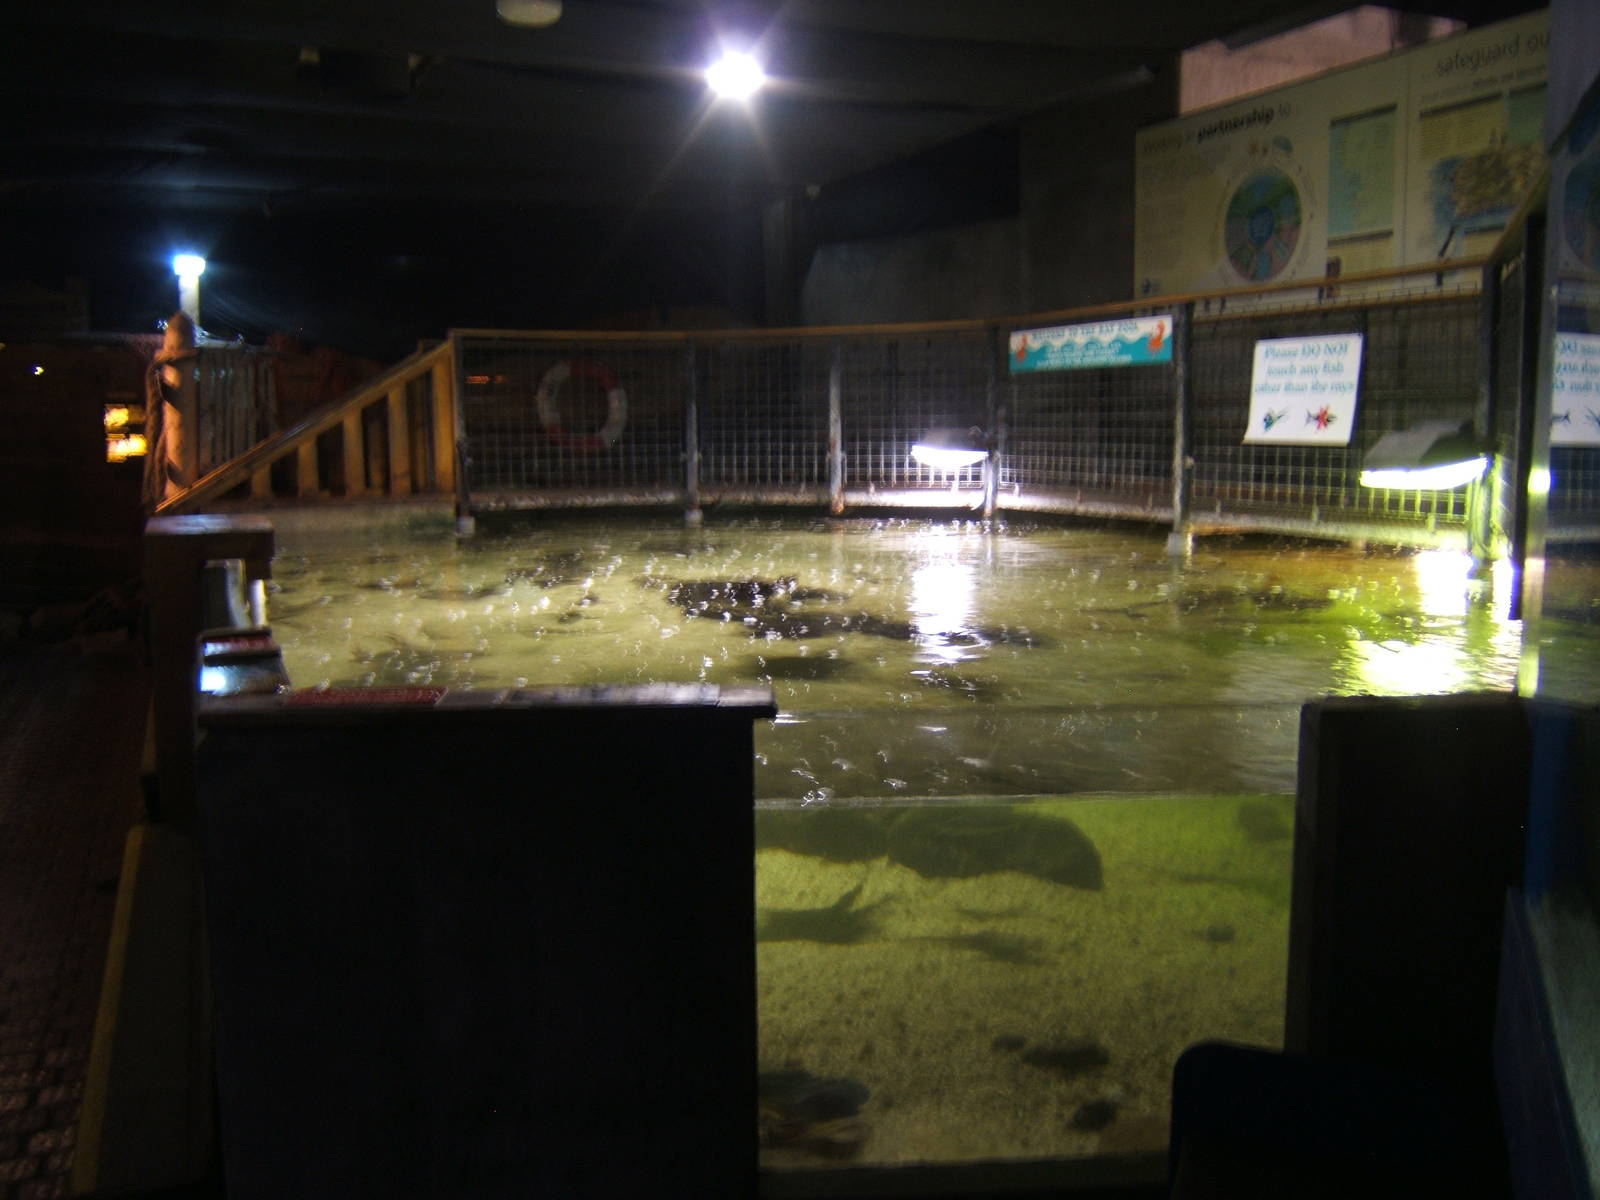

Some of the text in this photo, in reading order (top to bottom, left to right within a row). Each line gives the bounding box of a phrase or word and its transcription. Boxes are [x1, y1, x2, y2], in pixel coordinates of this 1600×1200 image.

[1197, 105, 1274, 143] partnership
[1264, 342, 1347, 358] Please DO NOT
